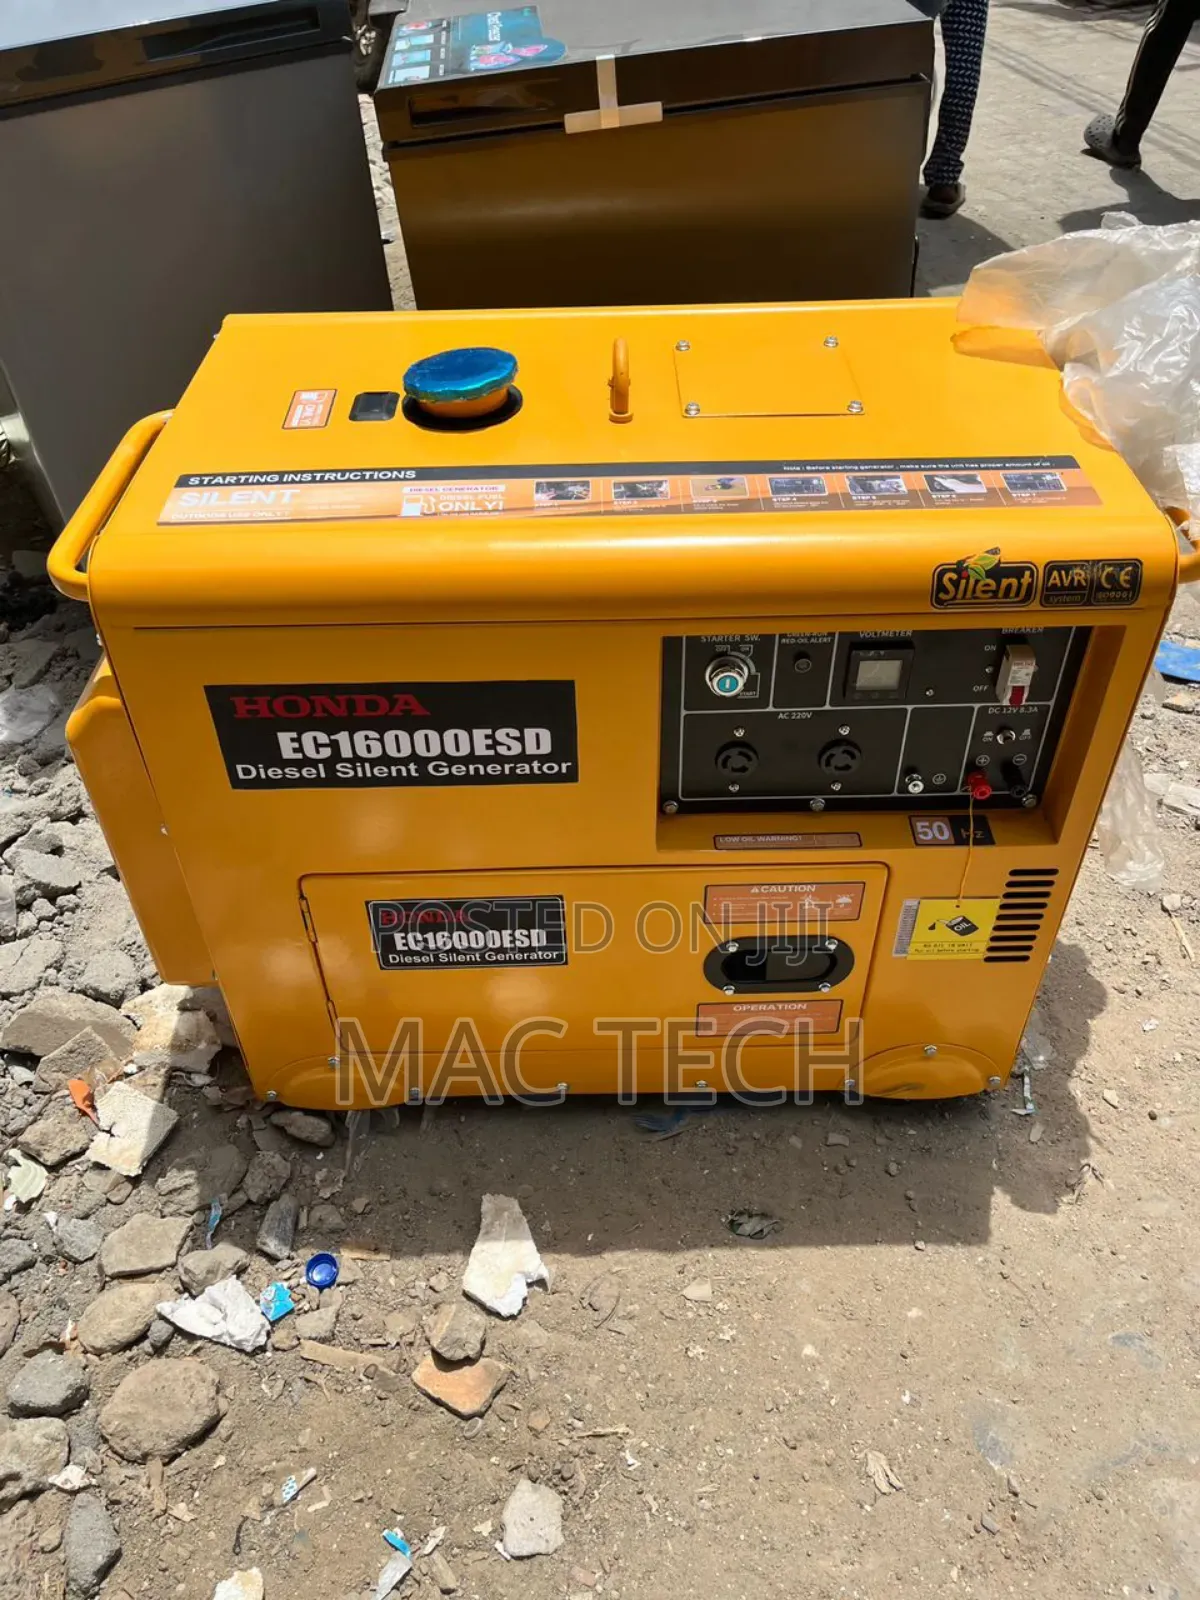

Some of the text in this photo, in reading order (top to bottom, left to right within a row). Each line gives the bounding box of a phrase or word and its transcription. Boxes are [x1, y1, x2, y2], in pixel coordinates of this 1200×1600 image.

[188, 470, 417, 485] STARTING INSTRUCTIONS
[179, 489, 301, 508] SILENT
[438, 500, 505, 512] ONLY!
[939, 569, 1032, 600] Silent
[1048, 569, 1087, 587] AVR
[859, 630, 913, 639] VOLTMETER
[1001, 627, 1045, 635] BREAKER
[700, 635, 741, 643] STARTER
[972, 685, 989, 693] OFF
[229, 693, 431, 718] HONDA
[988, 707, 1000, 715] DC
[1002, 706, 1018, 714] 12V
[778, 711, 813, 720] AC 220V
[276, 727, 552, 760] EC16000ESD
[236, 760, 572, 779] Diesel Silent Generator
[915, 821, 950, 841] 50
[761, 884, 817, 893] CAUTION
[380, 909, 473, 925] HONDA
[953, 922, 971, 932] OIL
[394, 929, 547, 951] EC16000ESD
[389, 950, 559, 964] Diesel Silent Generator
[733, 1003, 808, 1012] OPERATION
